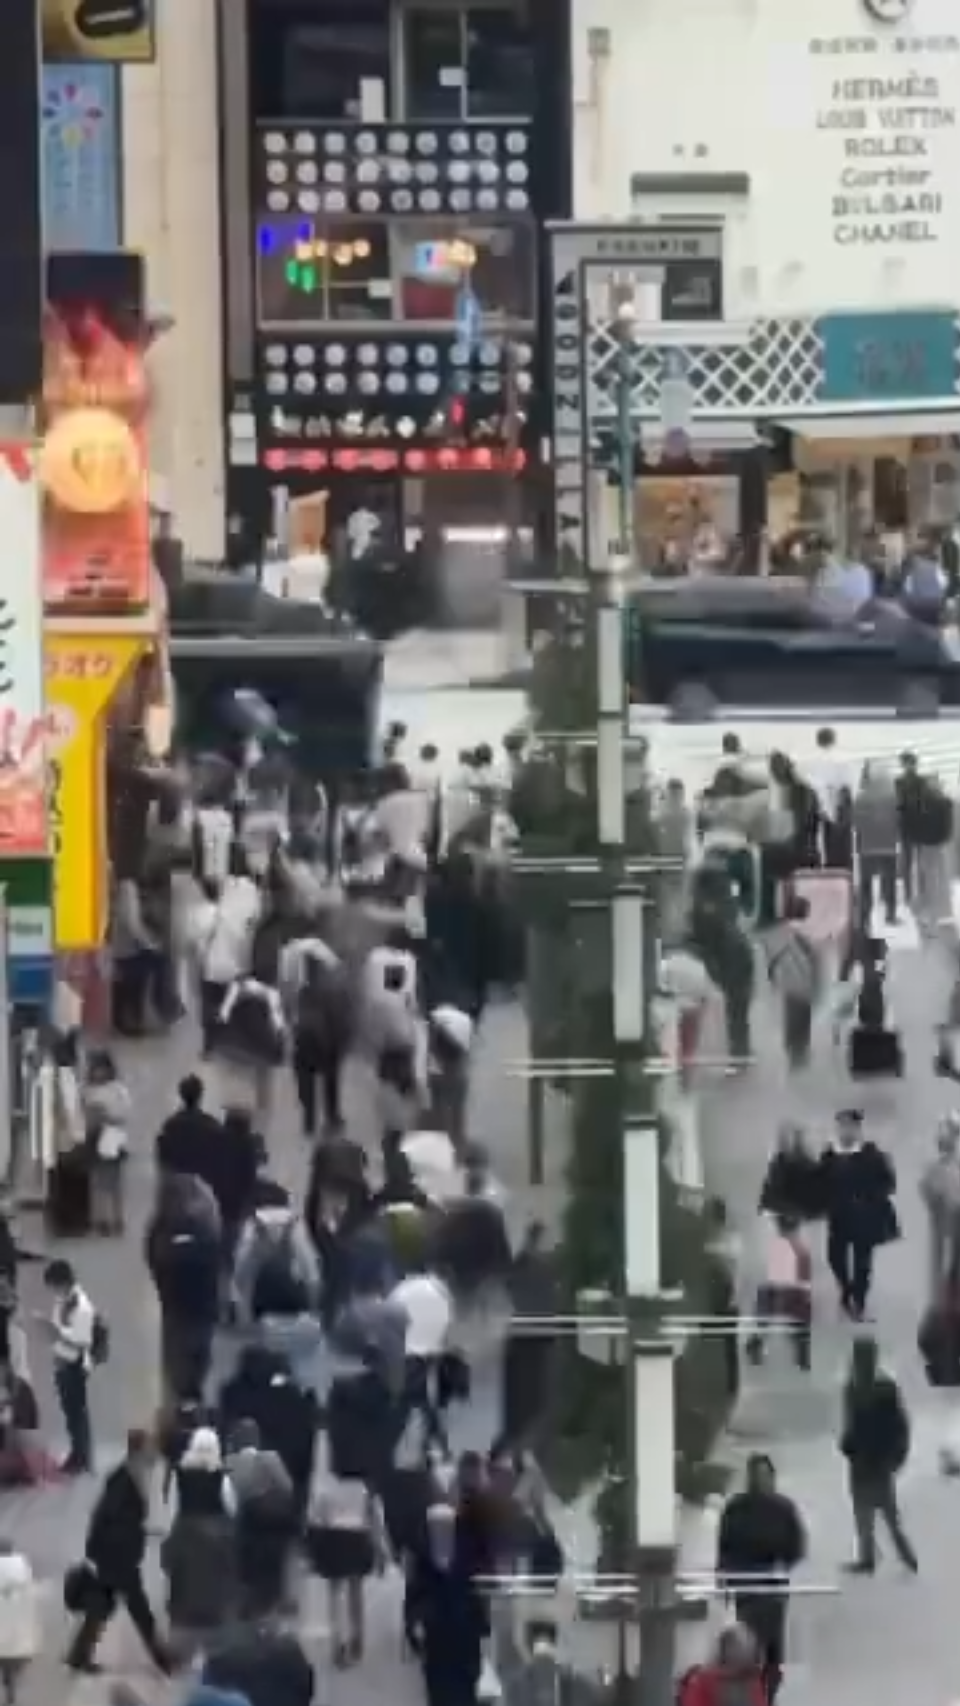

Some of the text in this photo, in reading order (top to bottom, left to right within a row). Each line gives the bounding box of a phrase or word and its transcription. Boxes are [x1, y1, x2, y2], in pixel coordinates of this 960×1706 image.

[832, 68, 939, 101] HERMÈS
[844, 135, 928, 157] ROLEX
[840, 165, 932, 188] Cartier
[833, 220, 939, 245] CHANEL
